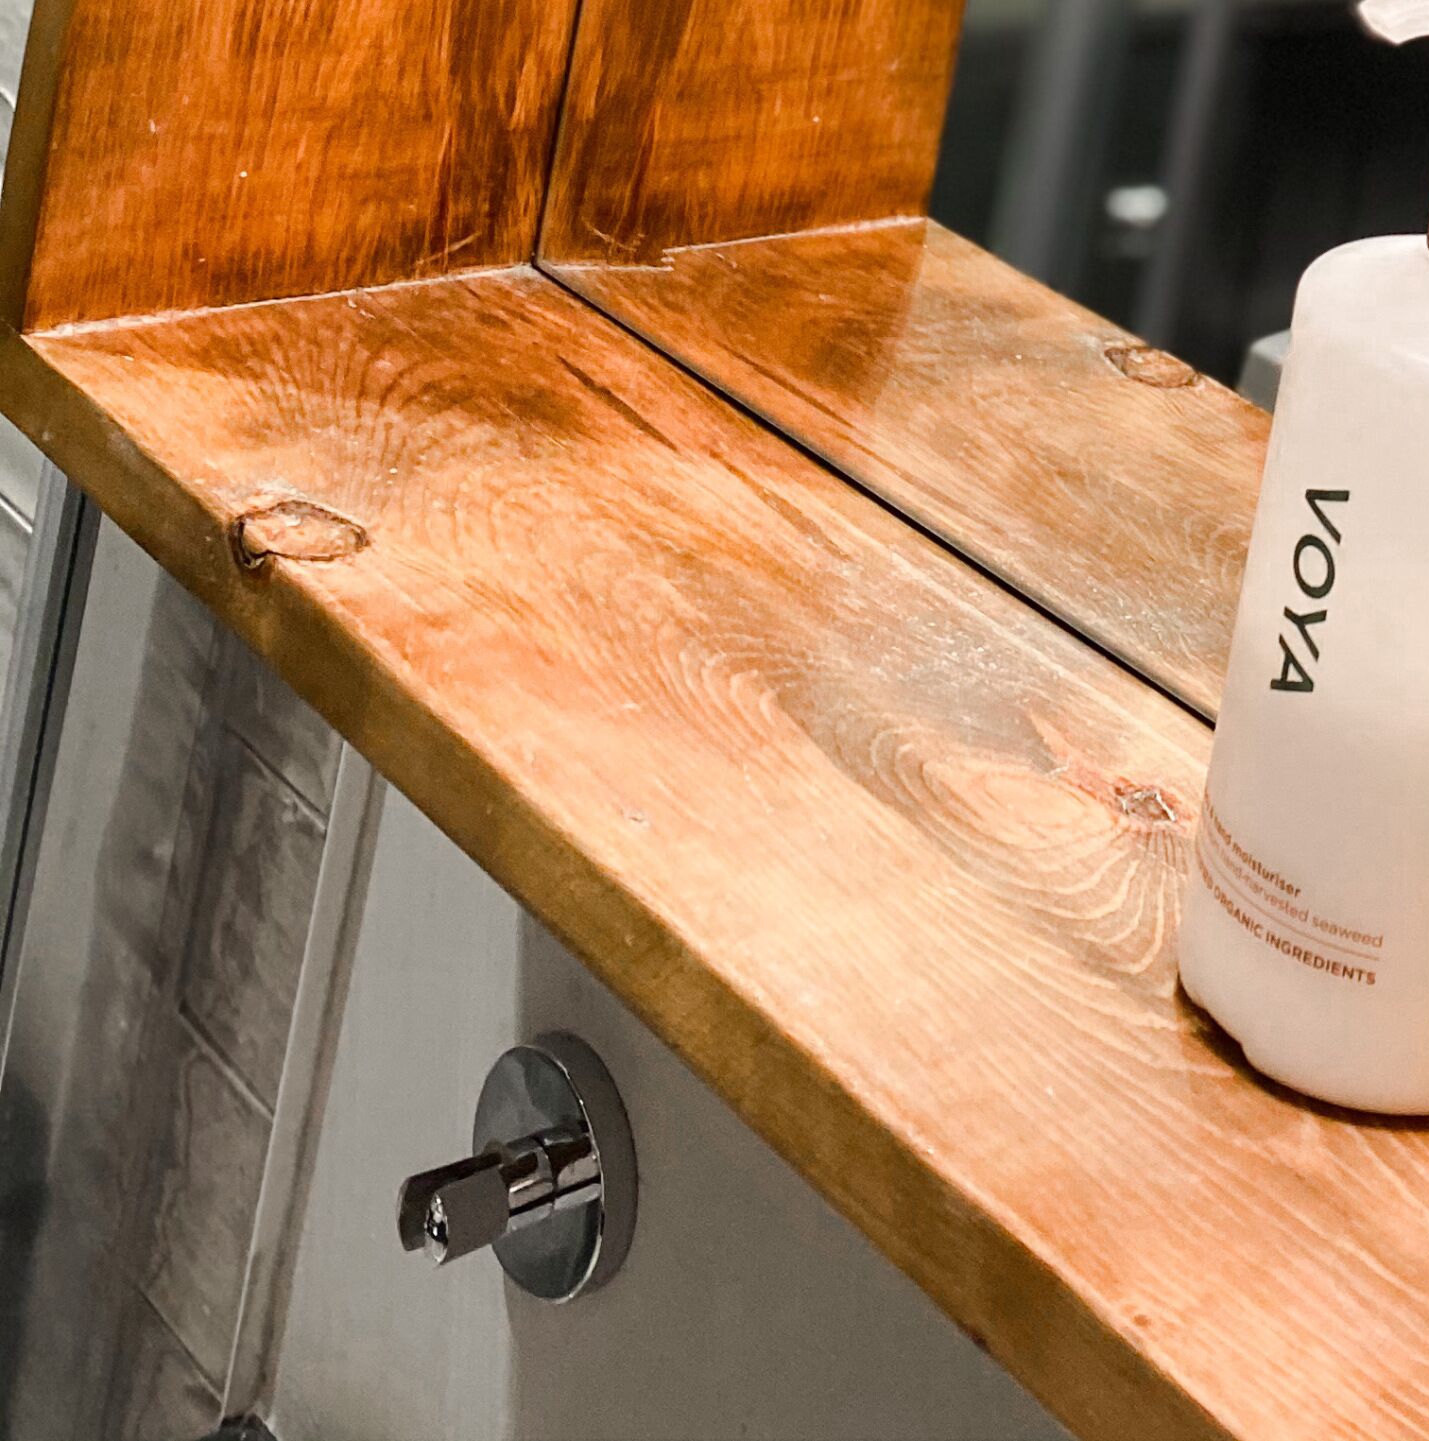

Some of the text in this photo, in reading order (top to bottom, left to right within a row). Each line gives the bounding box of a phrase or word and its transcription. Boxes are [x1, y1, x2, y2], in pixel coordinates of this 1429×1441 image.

[1270, 488, 1350, 693] VOYA
[1231, 841, 1302, 899] moisturiser
[1213, 884, 1377, 986] ORGANIC INGREDIENTS
[1312, 915, 1384, 949] seaweed
